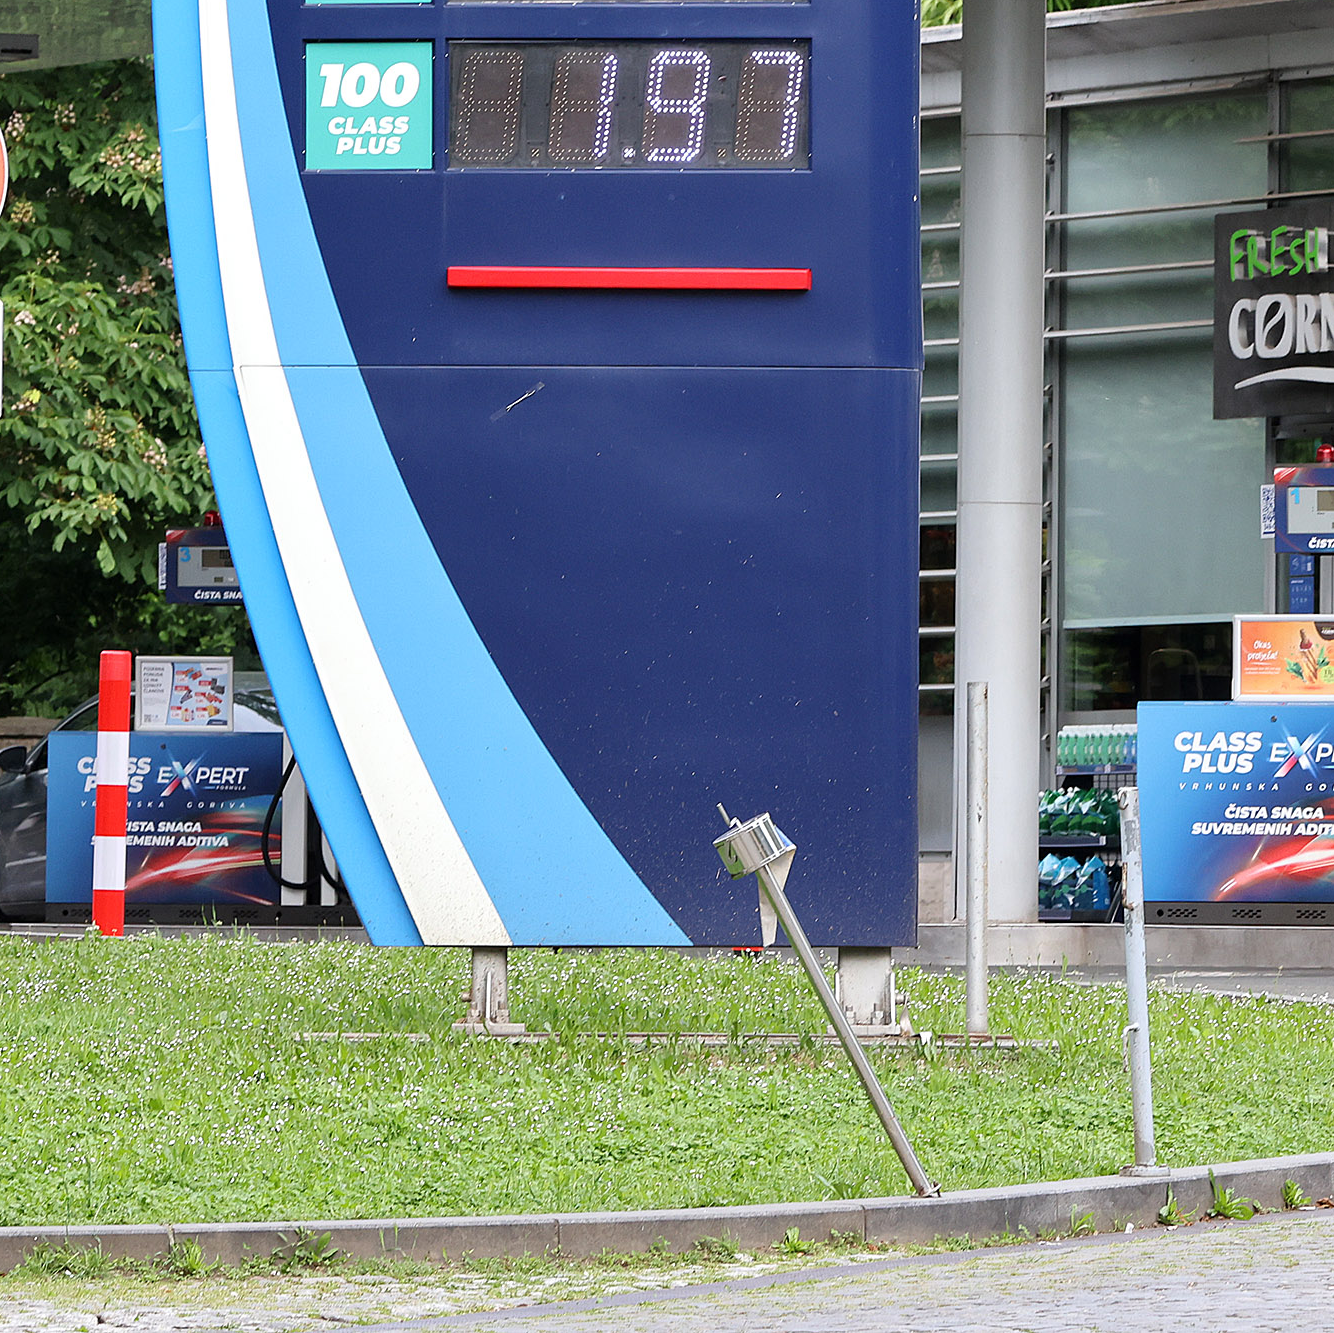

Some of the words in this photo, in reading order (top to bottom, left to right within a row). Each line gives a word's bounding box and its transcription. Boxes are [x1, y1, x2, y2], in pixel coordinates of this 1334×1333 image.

[319, 62, 421, 108] 100
[594, 50, 805, 162] 1.97
[328, 116, 410, 135] CLASS
[335, 136, 402, 155] PLUS
[1230, 226, 1324, 282] FRESH
[1290, 487, 1300, 504] 1
[180, 547, 192, 562] 3
[194, 589, 221, 600] ČISTA
[223, 591, 244, 600] SNA
[1174, 731, 1263, 753] CLASS
[1182, 753, 1255, 774] PLUS
[156, 759, 250, 797] EXPERT
[1179, 782, 1280, 791] VRHUNSKA
[187, 800, 246, 809] GORIVA
[1224, 804, 1268, 819] ČISTA
[1270, 806, 1325, 819] SNAGA
[125, 820, 156, 832] ISTA
[156, 822, 202, 832] SNAGA
[1191, 822, 1293, 836] SUVREMENIH
[174, 835, 230, 847] ADITIVA
